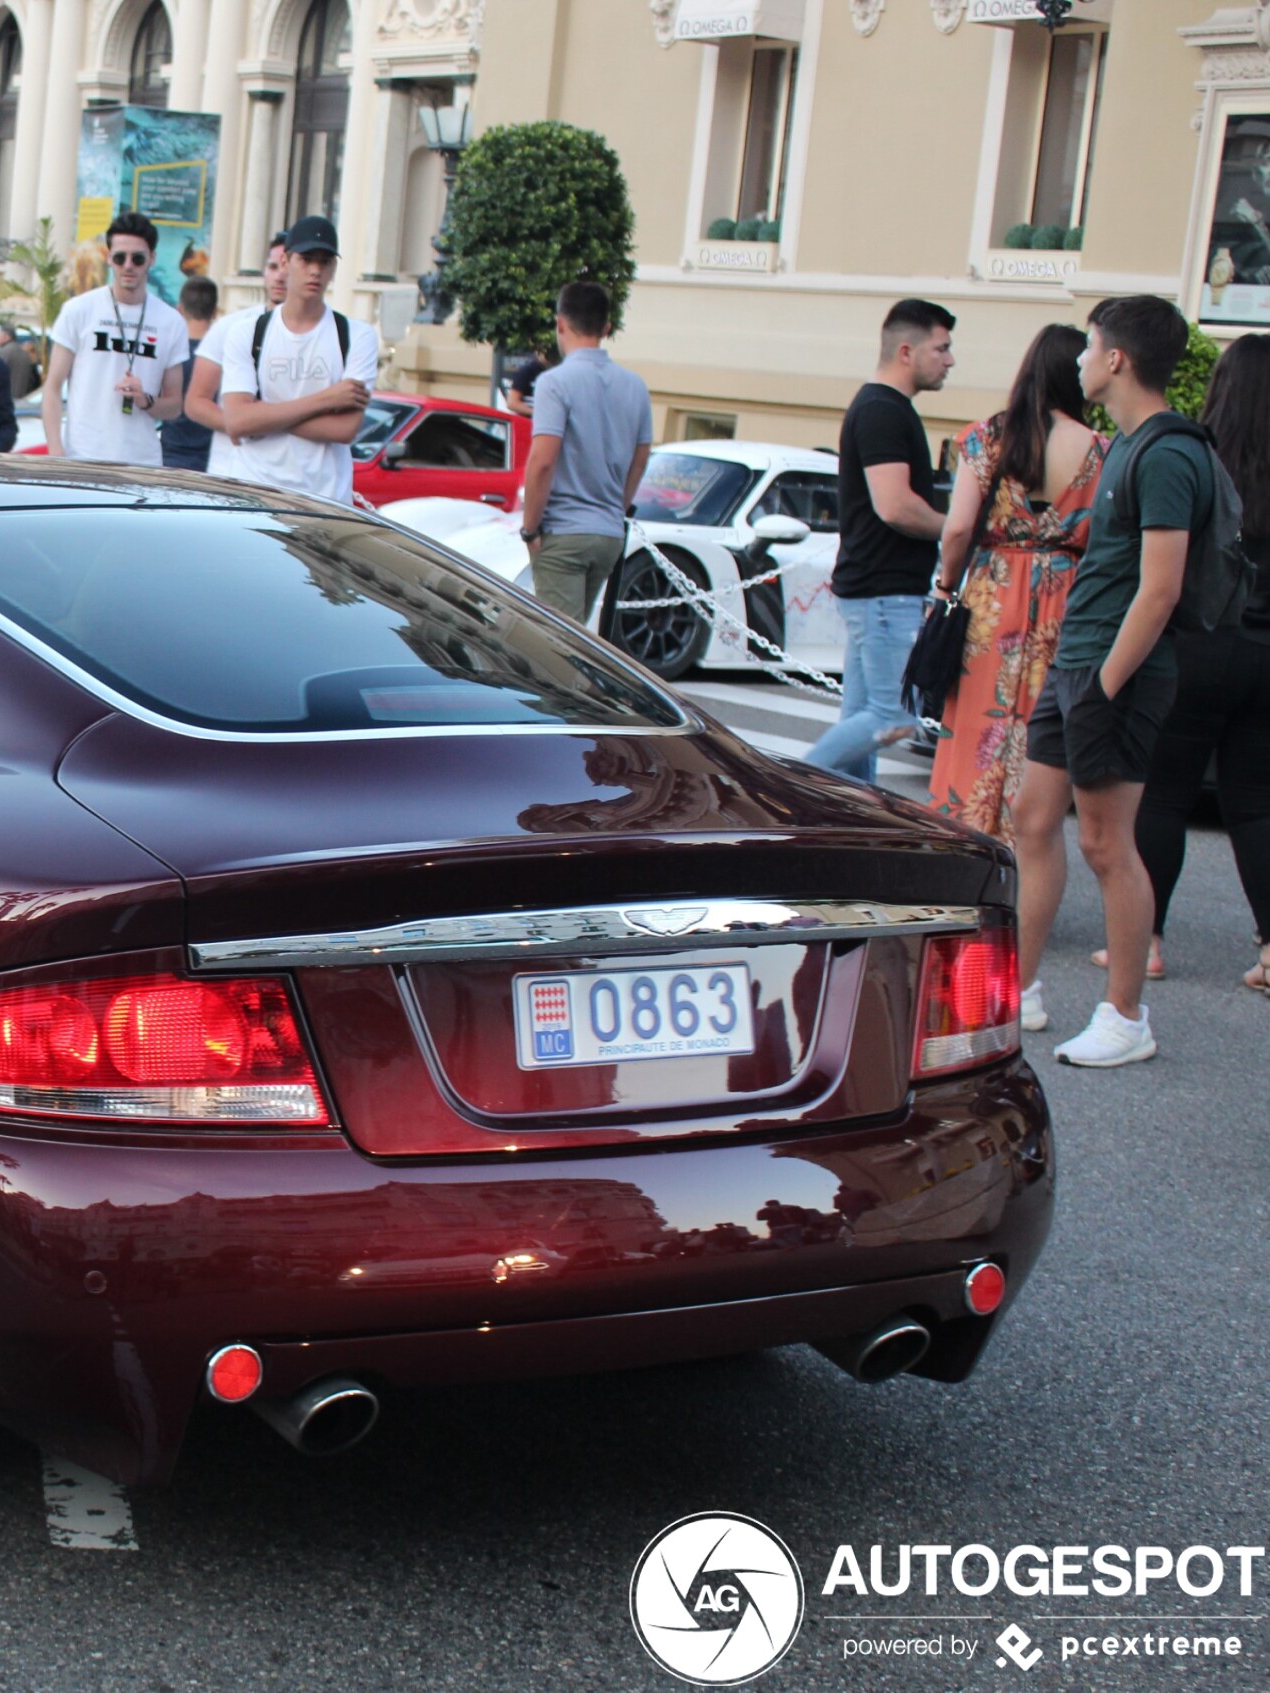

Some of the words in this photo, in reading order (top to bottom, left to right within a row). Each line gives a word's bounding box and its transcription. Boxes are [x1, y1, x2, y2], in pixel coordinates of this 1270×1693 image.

[990, 0, 1035, 17] OMEG
[692, 19, 733, 35] OMEGA
[713, 250, 752, 266] OMEGA
[1008, 260, 1058, 278] OMEGA
[93, 331, 158, 359] lui
[269, 355, 330, 381] FILA
[589, 970, 738, 1043] 0863
[540, 1033, 567, 1053] MC
[598, 1041, 667, 1056] PRINCIPAUTE
[670, 1040, 684, 1051] DE
[686, 1037, 730, 1050] MONACO
